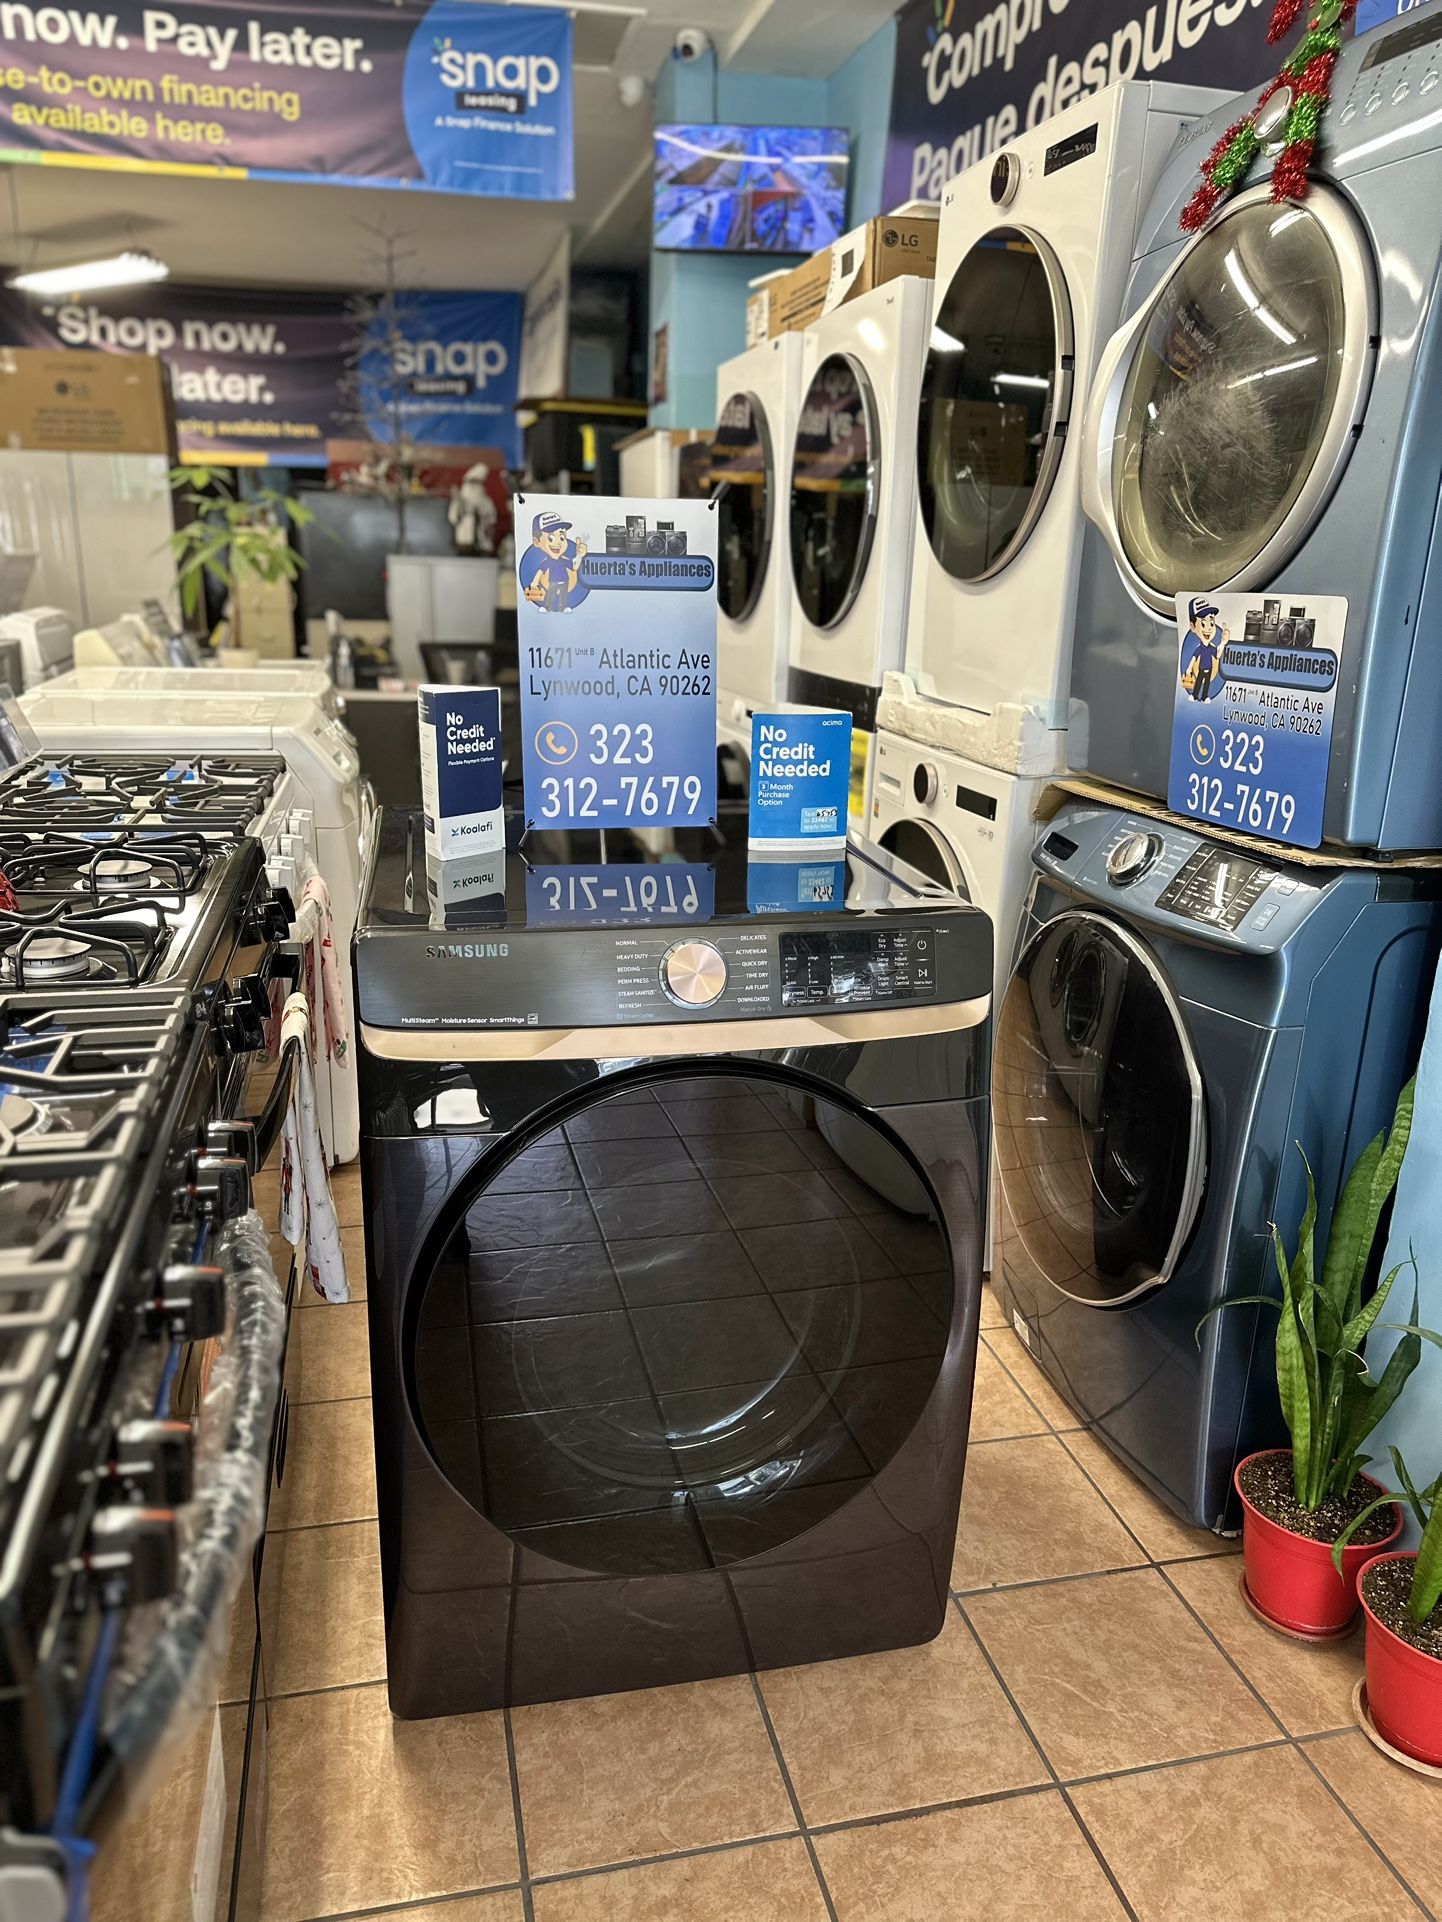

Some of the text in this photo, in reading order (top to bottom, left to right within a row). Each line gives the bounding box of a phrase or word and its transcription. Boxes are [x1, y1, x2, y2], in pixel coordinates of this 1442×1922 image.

[1, 2, 374, 73] now. Pay later.
[440, 50, 560, 107] snap
[160, 74, 300, 122] financing
[463, 93, 518, 112] leasing
[11, 102, 232, 145] available here.
[902, 234, 918, 247] LG
[57, 305, 287, 356] Shop now.
[393, 339, 508, 389] snap
[582, 559, 712, 578] Huerta's Appliances
[528, 647, 573, 669] 11671
[575, 647, 588, 656] Unit
[599, 648, 671, 669] Atlantic
[677, 649, 710, 669] Ave
[1222, 647, 1335, 676] Huerta's Appliances
[530, 674, 711, 701] Lynwood, CA 90262
[1225, 685, 1246, 703] 11671
[1259, 690, 1299, 712] Atlantic
[1302, 697, 1324, 715] Ave
[446, 712, 463, 726] No
[1222, 706, 1322, 736] Lynwood, CA 90262
[447, 724, 484, 741] Credit
[589, 723, 654, 765] 323
[760, 725, 787, 742] No
[759, 743, 815, 760] Credit
[1219, 730, 1265, 775] 323
[758, 760, 831, 777] Needed
[541, 775, 702, 818] 312-7679
[757, 799, 783, 807] Option
[758, 791, 790, 799] Purchase
[1186, 773, 1296, 835] 312-7679
[460, 821, 493, 837] Koalafi
[425, 943, 509, 959] SAMSUNG
[489, 1016, 525, 1024] SmartThings
